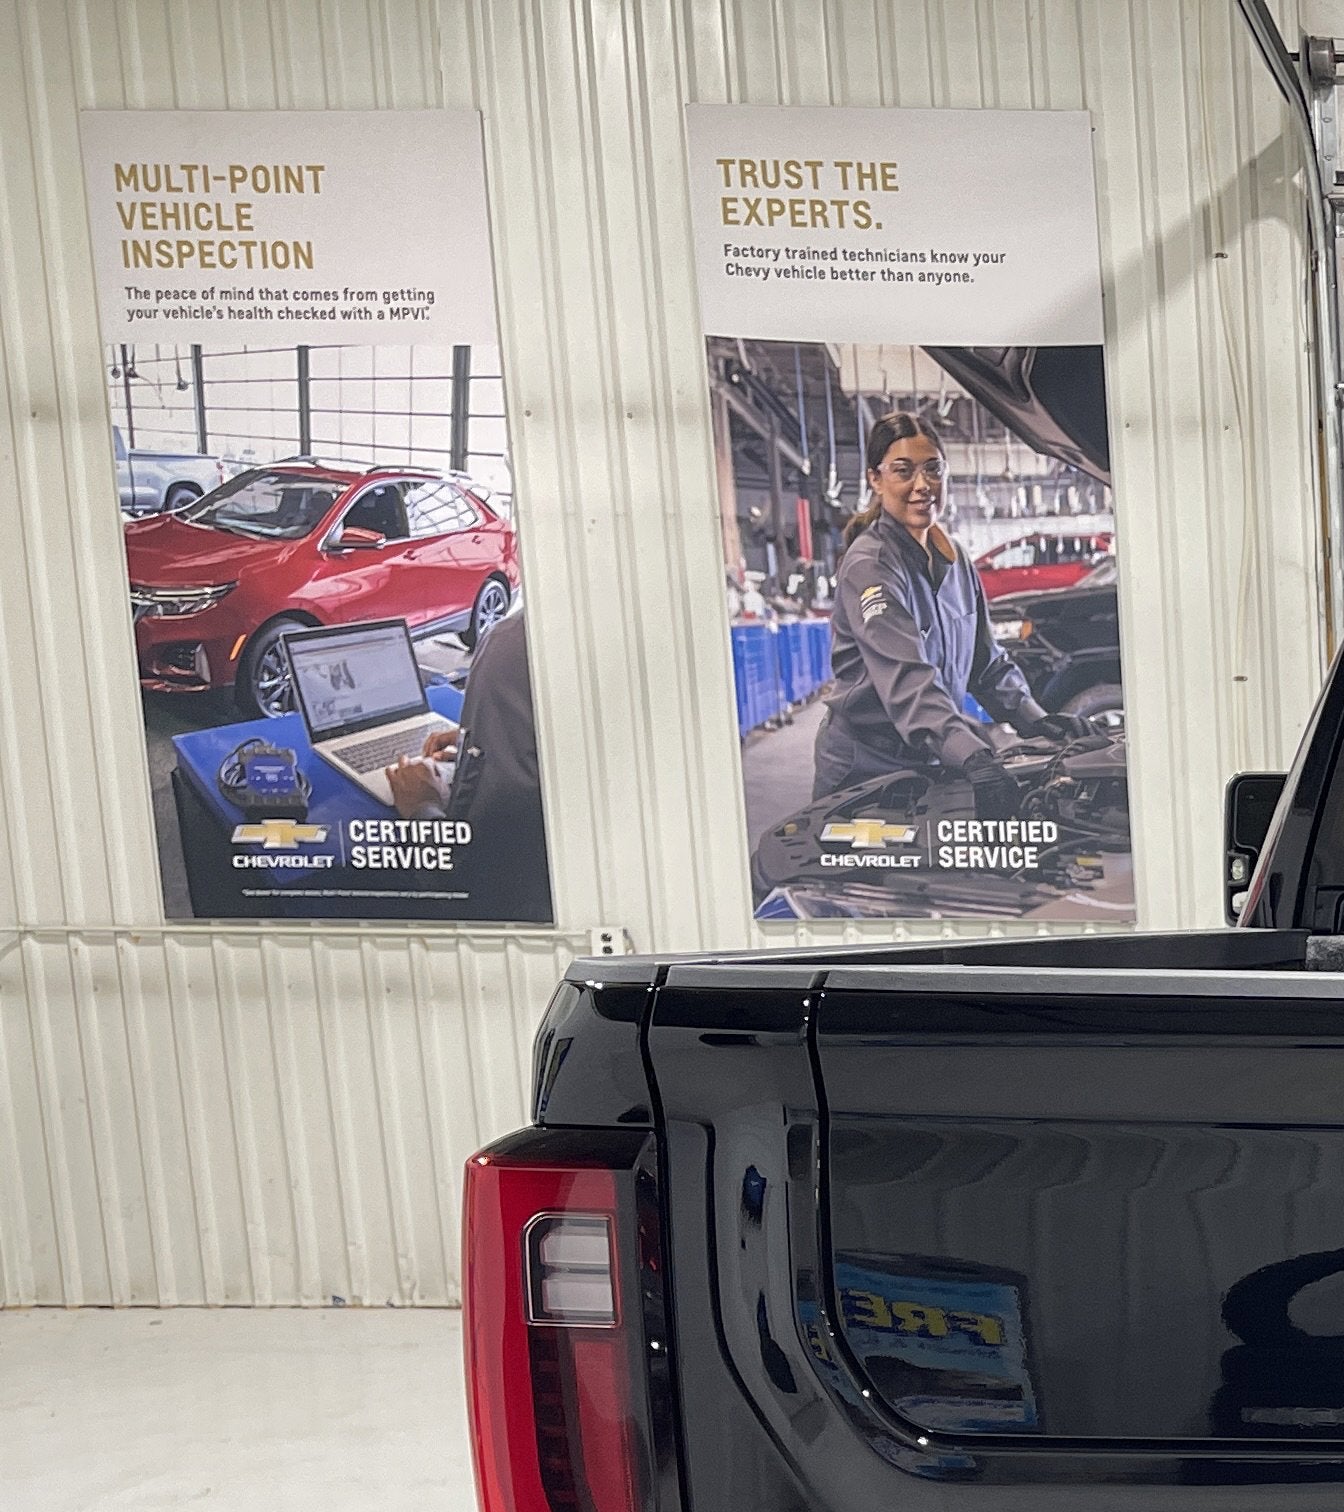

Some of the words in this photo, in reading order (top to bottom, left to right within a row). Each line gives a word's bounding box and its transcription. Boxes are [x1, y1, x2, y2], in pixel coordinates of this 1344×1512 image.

[114, 163, 325, 194] MULTI-POINT
[716, 158, 824, 190] TRUST
[834, 161, 899, 192] THE
[116, 202, 254, 232] VEHICLE
[721, 197, 883, 230] EXPERTS.
[121, 239, 315, 270] INSPECTION
[723, 244, 781, 262] Factory
[785, 246, 838, 262] trained
[842, 247, 926, 264] technicians
[930, 249, 968, 264] know
[972, 252, 1006, 267] your
[725, 263, 770, 281] Chevy
[774, 264, 826, 280] vehicle
[830, 266, 876, 282] better
[880, 267, 914, 283] than
[918, 270, 975, 286] anyone.
[125, 286, 152, 301] The
[155, 289, 197, 304] peace
[201, 287, 216, 301] of
[219, 286, 255, 301] mind
[258, 286, 289, 301] that
[292, 288, 339, 302] comes
[342, 287, 378, 302] from
[382, 287, 435, 305] getting
[127, 308, 159, 322] your
[163, 305, 224, 321] vehicle's
[227, 306, 274, 320] health
[277, 306, 337, 321] checked
[340, 306, 373, 321] with
[377, 309, 385, 321] a
[350, 820, 472, 844] CERTIFIED
[937, 820, 1057, 843] CERTIFIED
[232, 855, 335, 868] CHEVROLET
[351, 846, 454, 870] SERVICE
[820, 854, 921, 867] CHEVROLET
[938, 846, 1039, 868] SERVICE
